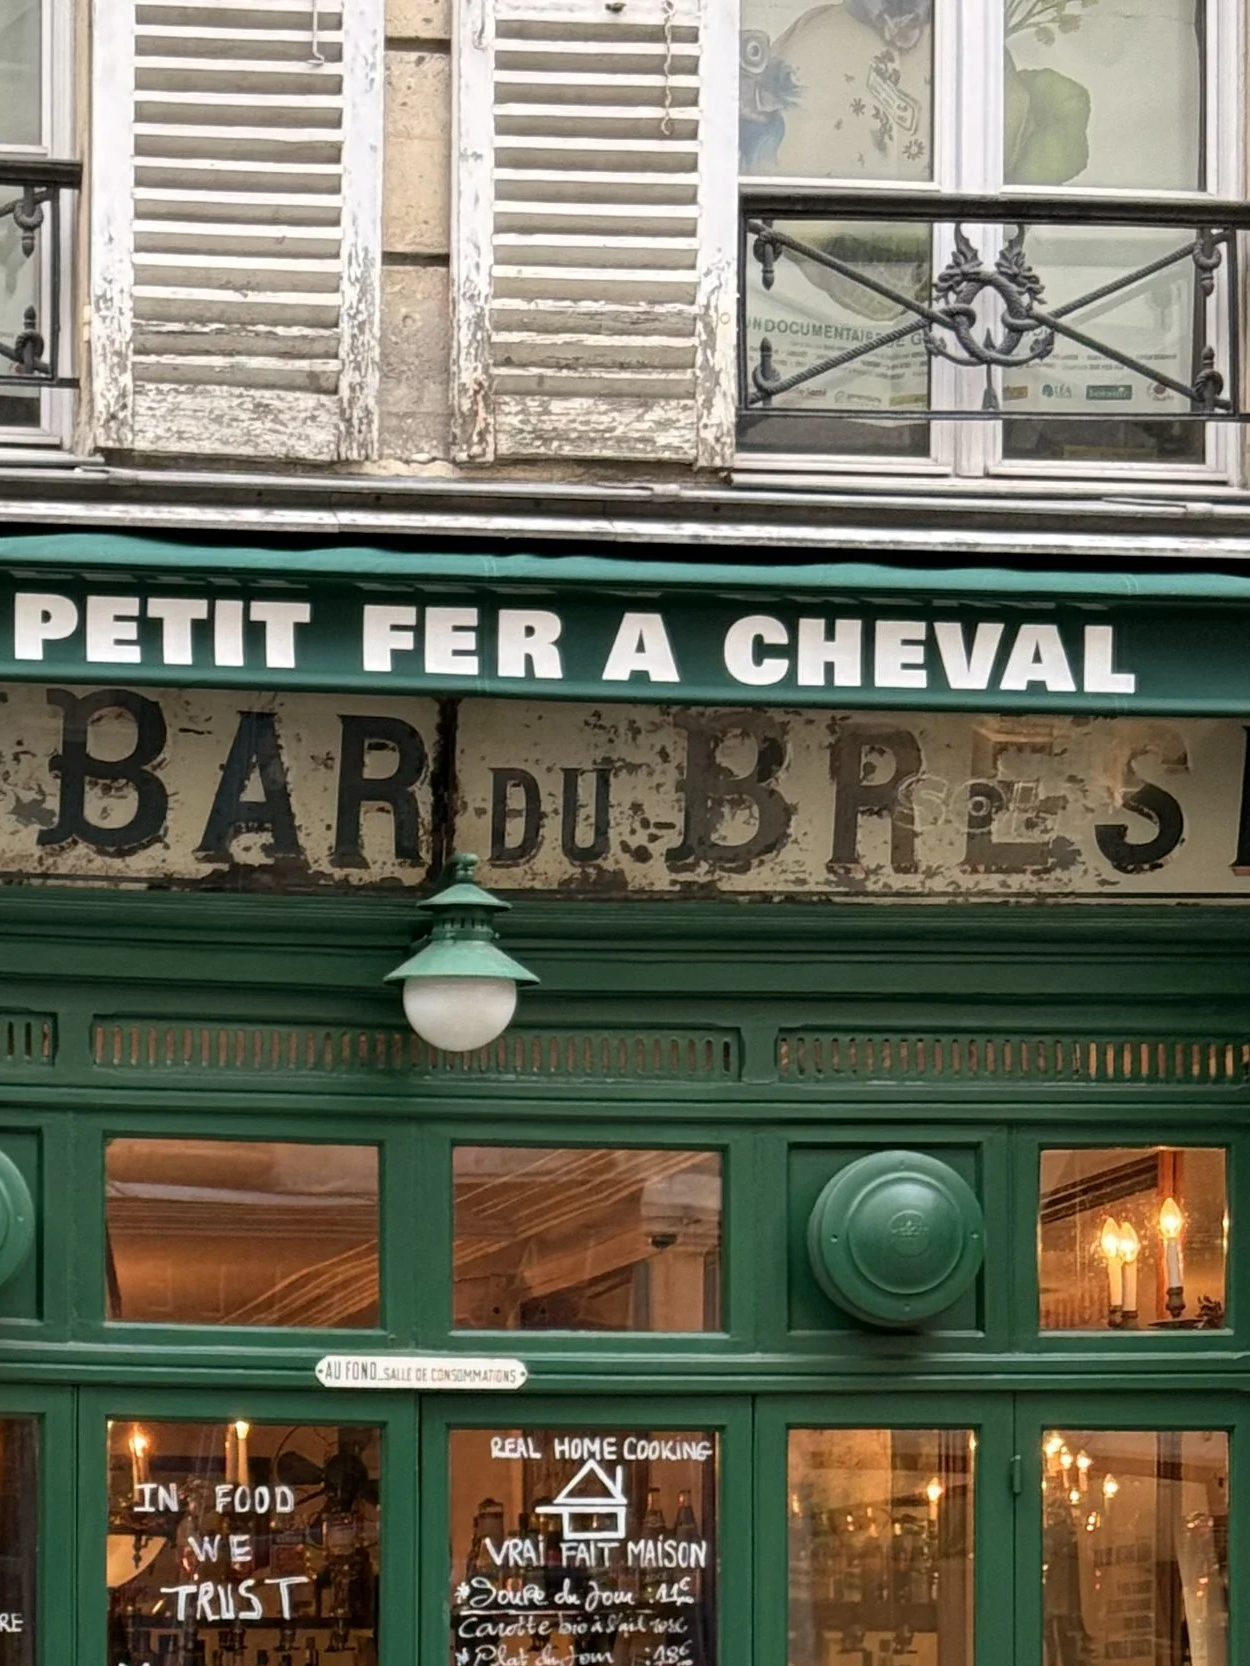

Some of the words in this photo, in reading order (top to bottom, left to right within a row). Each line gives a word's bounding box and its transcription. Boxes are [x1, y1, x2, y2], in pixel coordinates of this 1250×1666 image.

[14, 592, 311, 669] PETIT
[363, 604, 564, 681] FER
[601, 612, 680, 683] A
[723, 615, 1136, 694] CHEVAL
[37, 687, 432, 870] BAR
[488, 766, 614, 868] DU
[664, 706, 1250, 876] BRES
[325, 1361, 341, 1380] AU
[415, 1367, 429, 1382] DE
[431, 1367, 517, 1384] CONSOMMATIONS
[490, 1436, 542, 1459] REAL
[554, 1437, 617, 1461] HOME
[134, 1483, 179, 1513] IN
[215, 1484, 296, 1514] FOOD
[187, 1534, 253, 1562] WE
[559, 1541, 620, 1568] FAIT
[160, 1576, 310, 1622] TRUST
